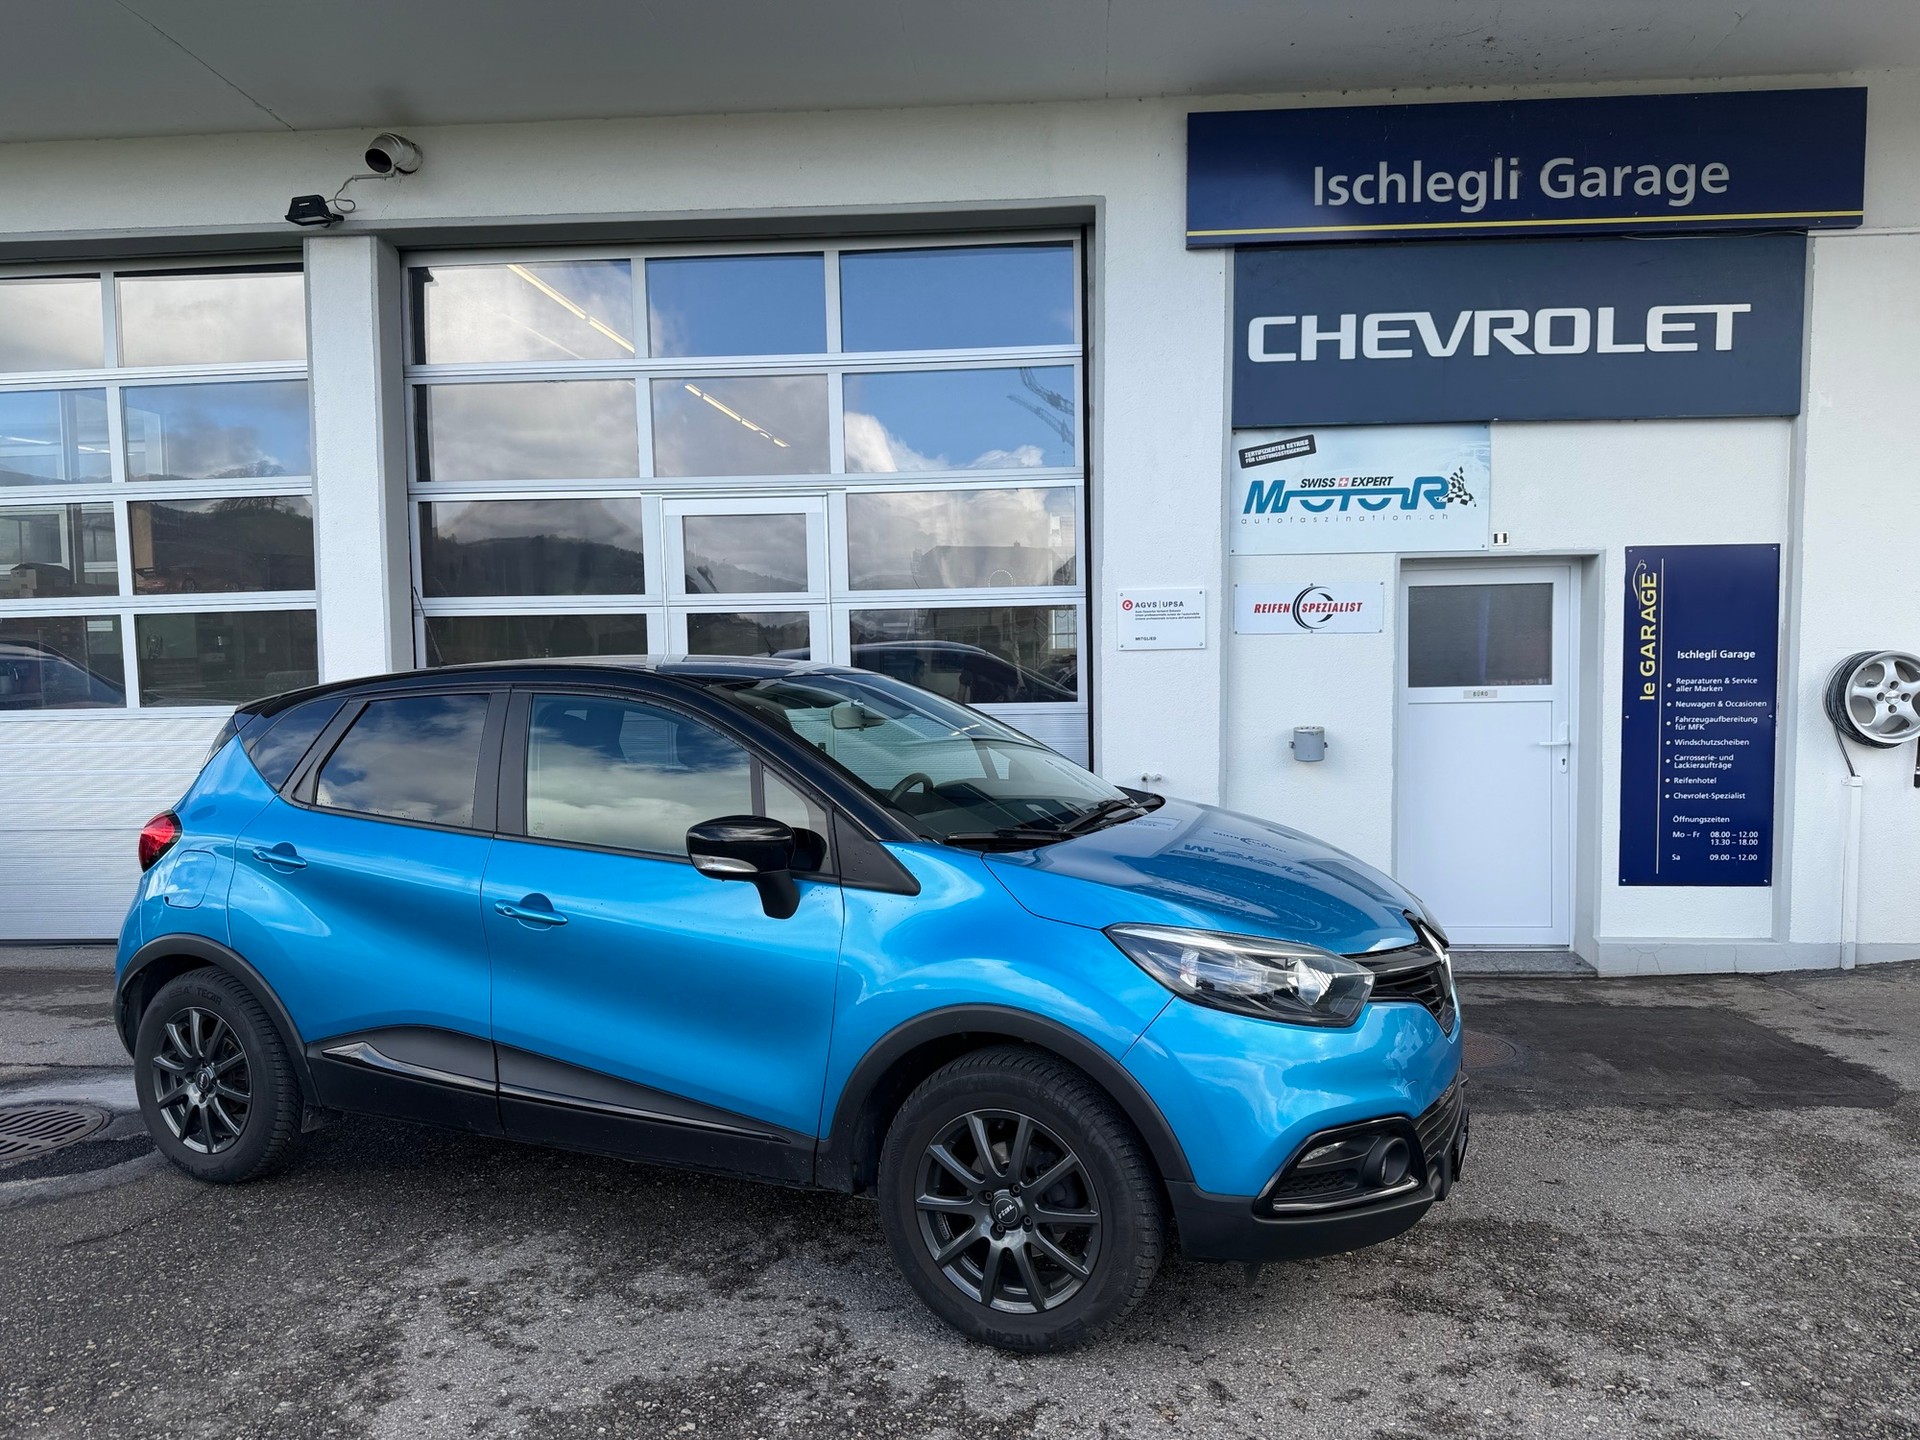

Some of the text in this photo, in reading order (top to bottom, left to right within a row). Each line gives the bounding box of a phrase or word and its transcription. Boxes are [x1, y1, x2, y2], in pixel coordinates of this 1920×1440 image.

[1313, 157, 1731, 213] Ischlegli Garage
[1247, 303, 1752, 363] CHEVROLET
[1300, 476, 1394, 489] SWISS EXPERT
[1241, 513, 1448, 524] autofaszination.ch
[1135, 600, 1185, 609] AGVS UPSA
[1254, 602, 1363, 613] REIFEN SPEZIALIST
[1640, 572, 1657, 701] le GARAGE
[1677, 650, 1756, 660] Ischlegli Garage
[1675, 677, 1723, 687] Reparaturen
[1731, 676, 1758, 684] Service
[1675, 700, 1768, 710] Neuwagen & Occasionen
[1675, 716, 1758, 724] Fahrzeugaufbereitung
[1675, 723, 1687, 731] für
[1674, 754, 1734, 762] Carrosserie- und
[1674, 761, 1732, 770] Lackieraufträge
[1673, 776, 1717, 785] Reifenhotel
[1673, 792, 1746, 800] Chevrolet-Spezialist
[1673, 815, 1730, 825] Öffnungszeiten
[197, 986, 222, 1006] TECAR
